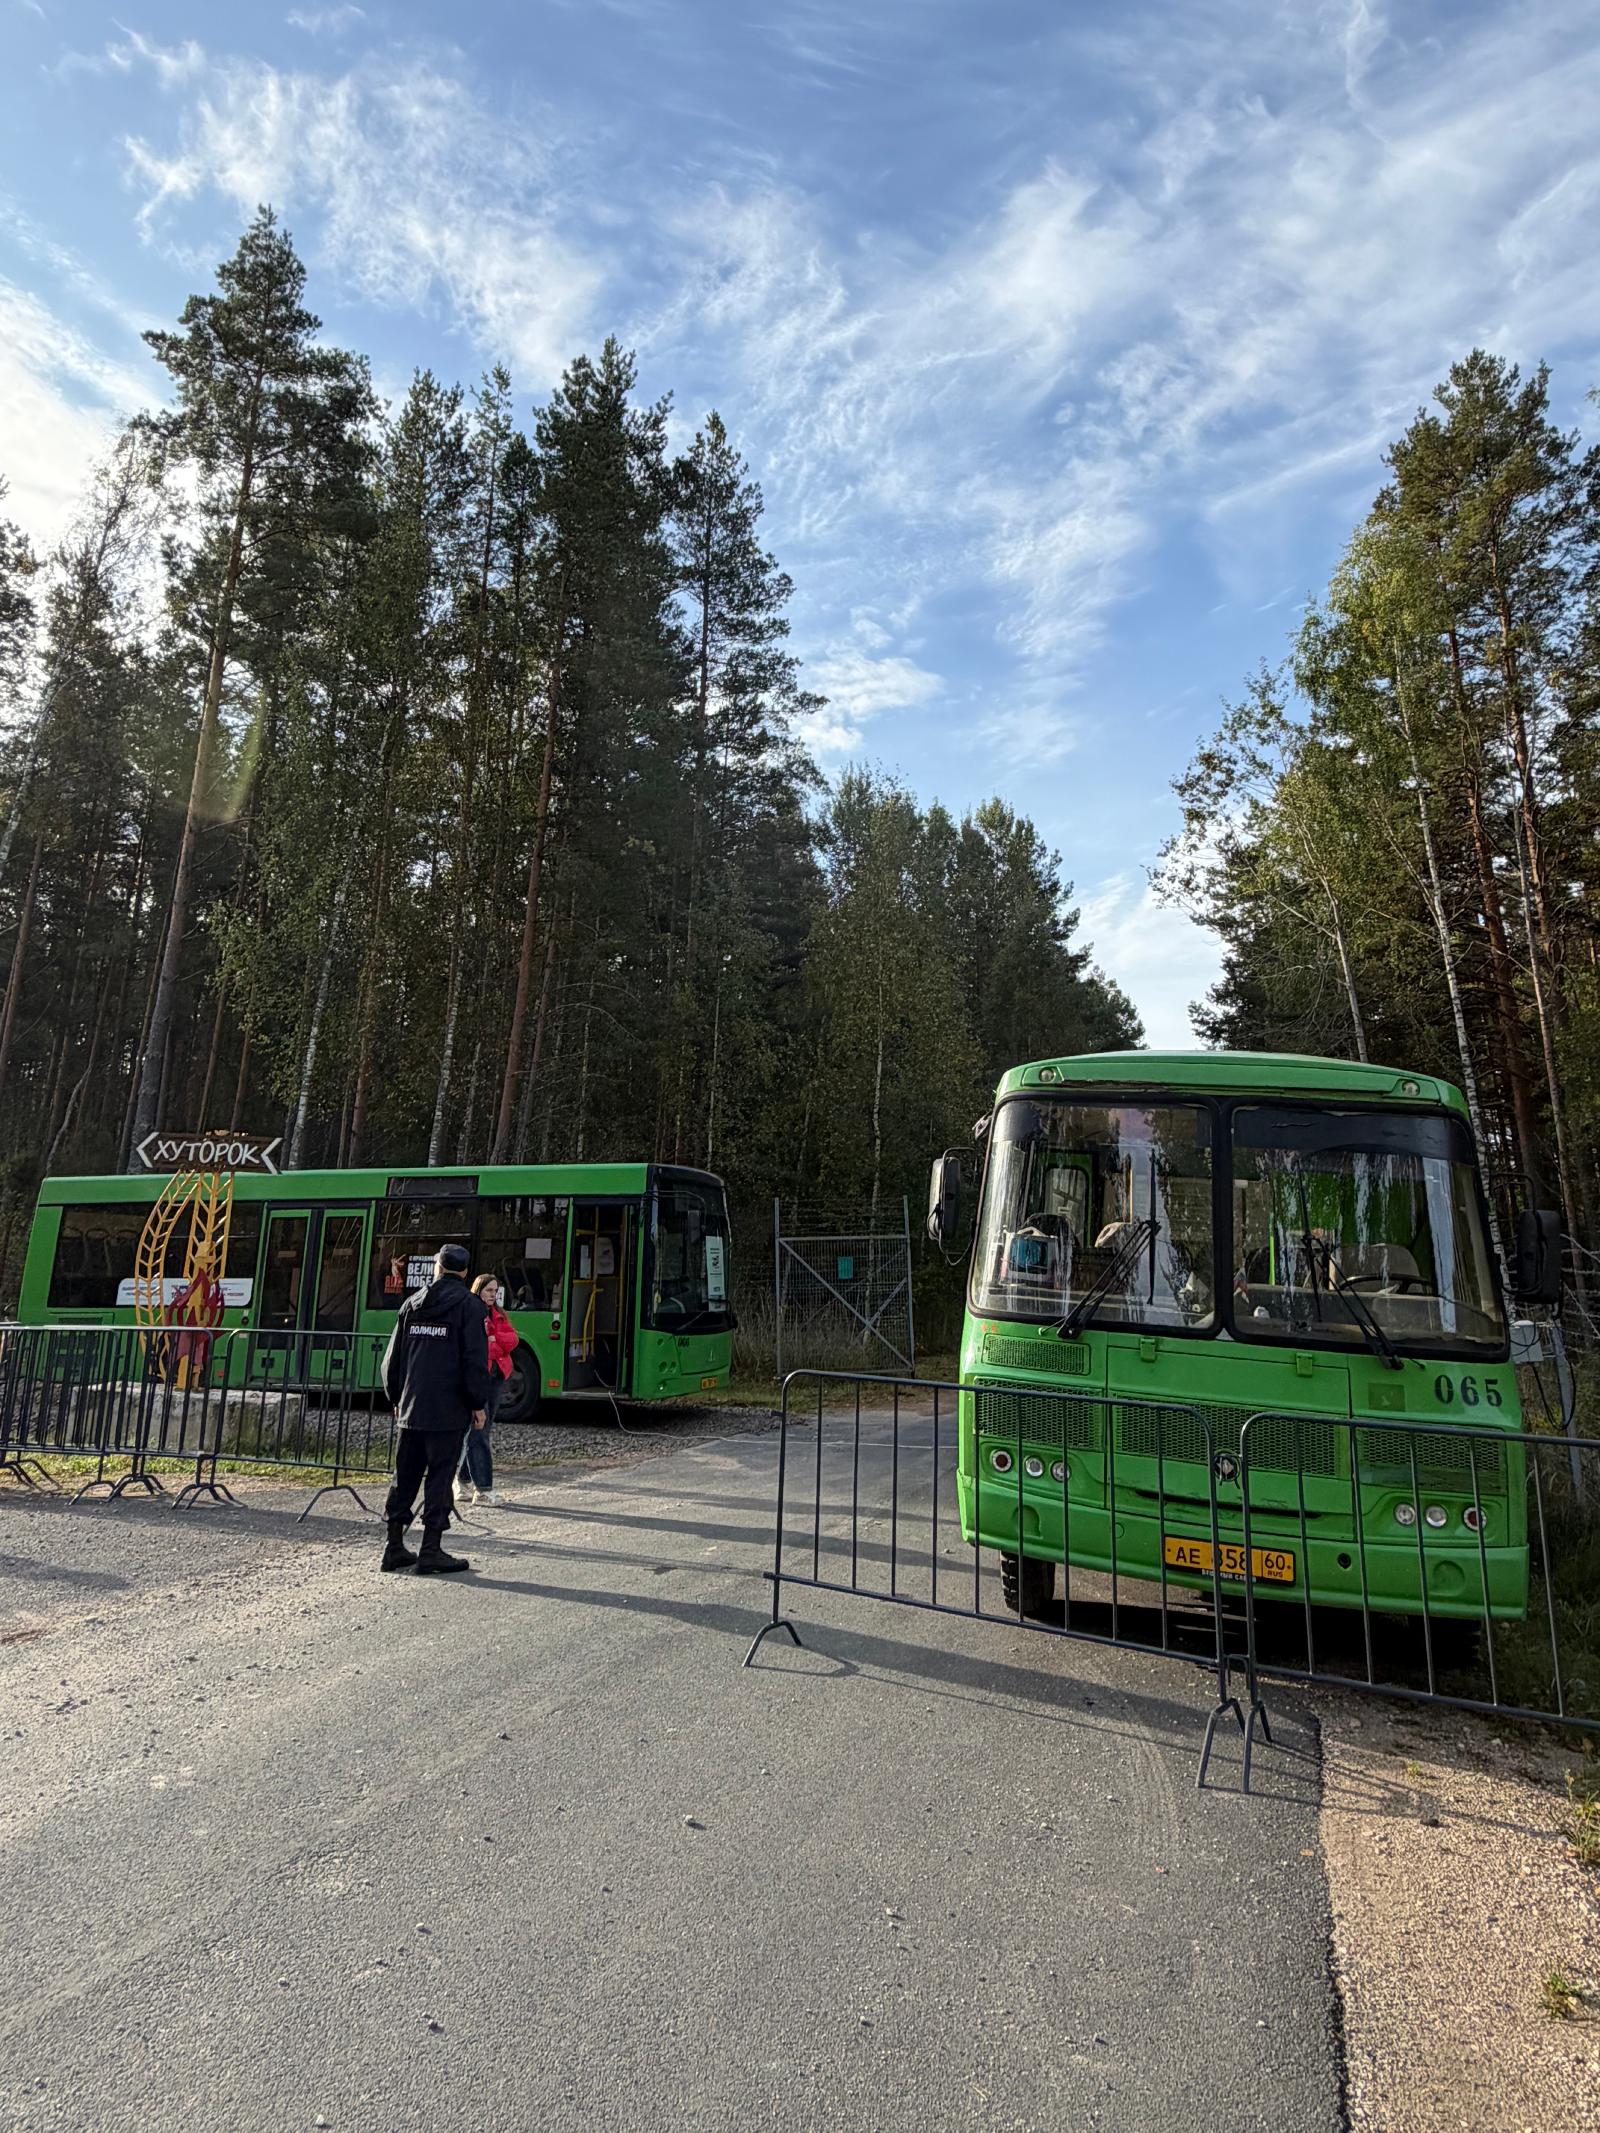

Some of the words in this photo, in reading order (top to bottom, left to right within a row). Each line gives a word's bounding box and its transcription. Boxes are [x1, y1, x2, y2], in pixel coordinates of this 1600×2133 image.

[153, 1139, 260, 1166] ХУТОРОК
[407, 1262, 433, 1275] ВЕЛИ
[406, 1275, 433, 1288] ПОБЕ
[409, 1325, 447, 1337] ПОЛИЦИЯ
[1434, 1374, 1503, 1407] 065
[1264, 1553, 1286, 1570] 60
[1267, 1570, 1283, 1578] RUS
